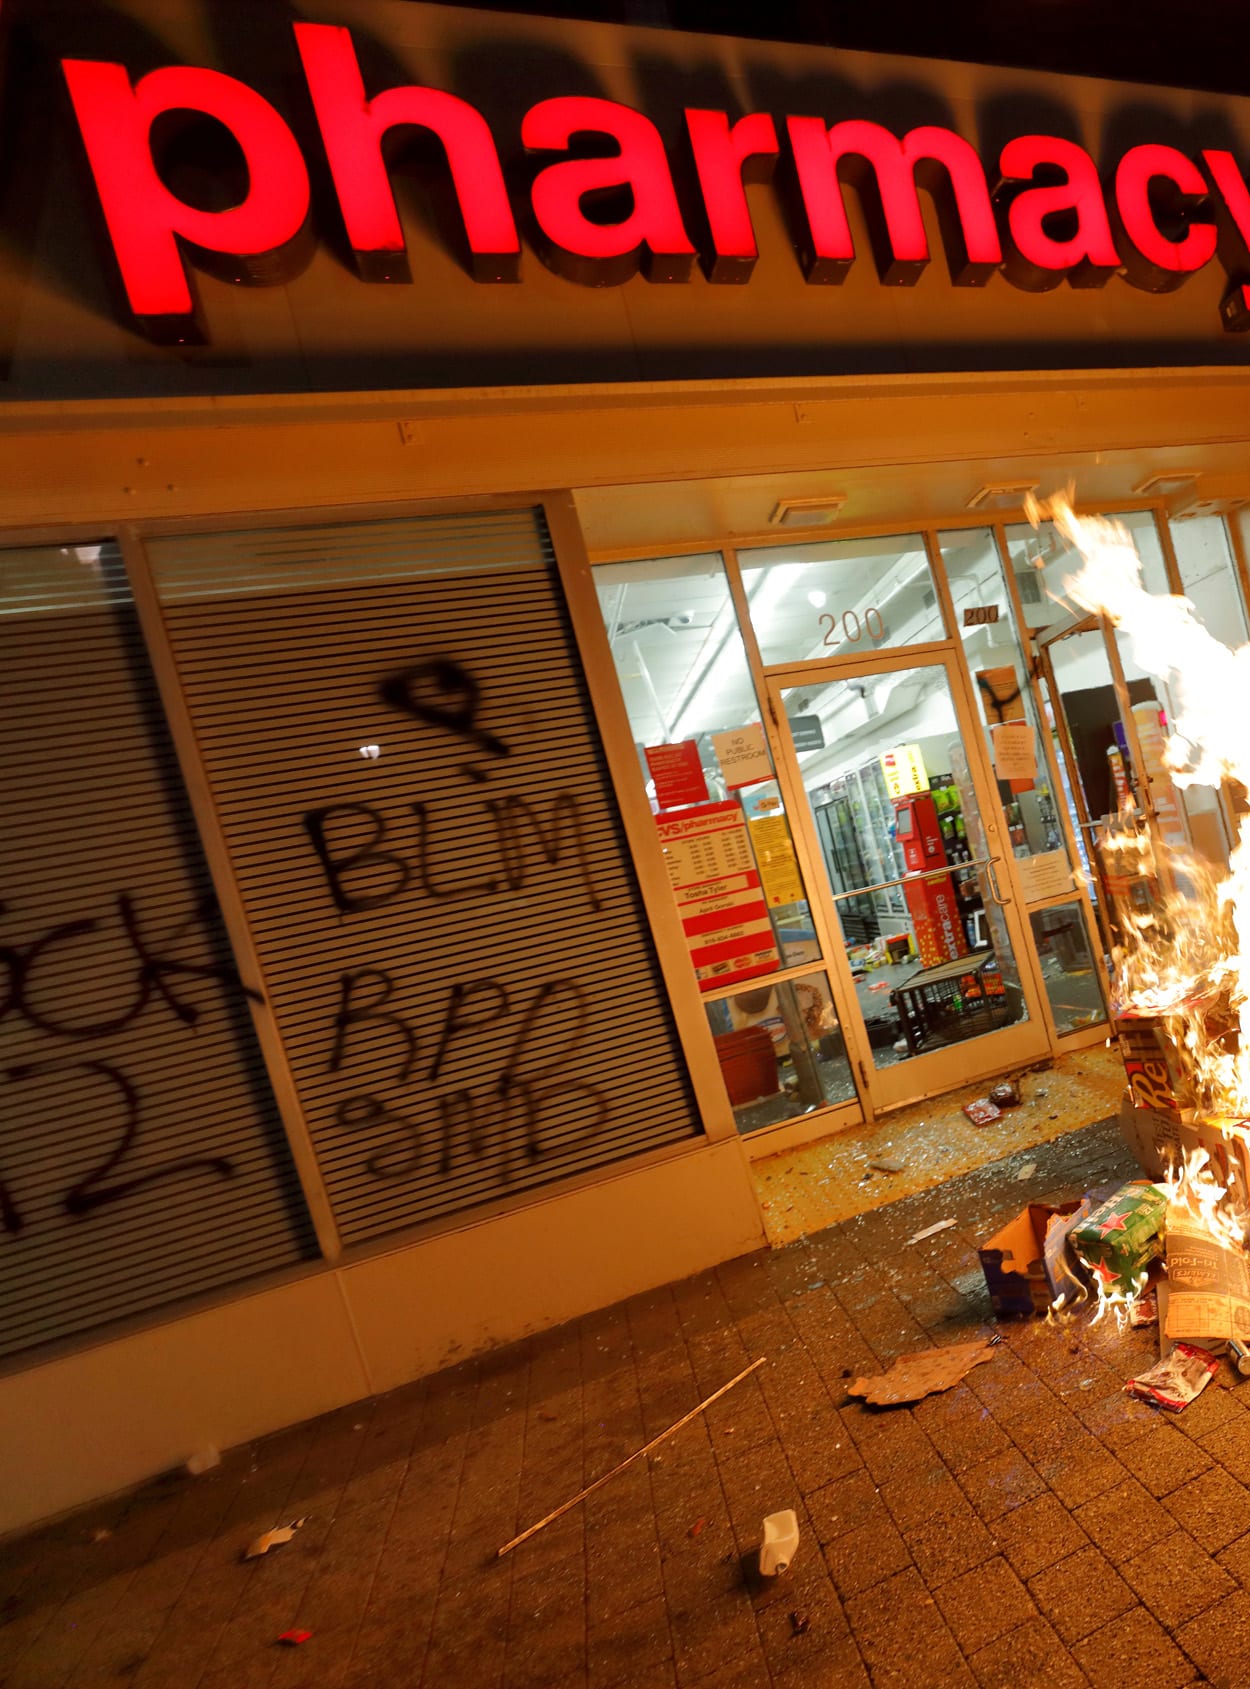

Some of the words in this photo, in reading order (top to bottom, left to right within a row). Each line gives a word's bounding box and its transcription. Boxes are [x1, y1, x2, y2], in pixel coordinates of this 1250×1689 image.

[818, 607, 884, 646] 200
[965, 605, 998, 626] 200
[725, 744, 755, 756] PUBLIC
[731, 737, 744, 746] NO
[719, 750, 766, 766] RESTROOM
[304, 788, 603, 916] BLM
[935, 894, 959, 961] extracare
[0, 1061, 234, 1236] 2
